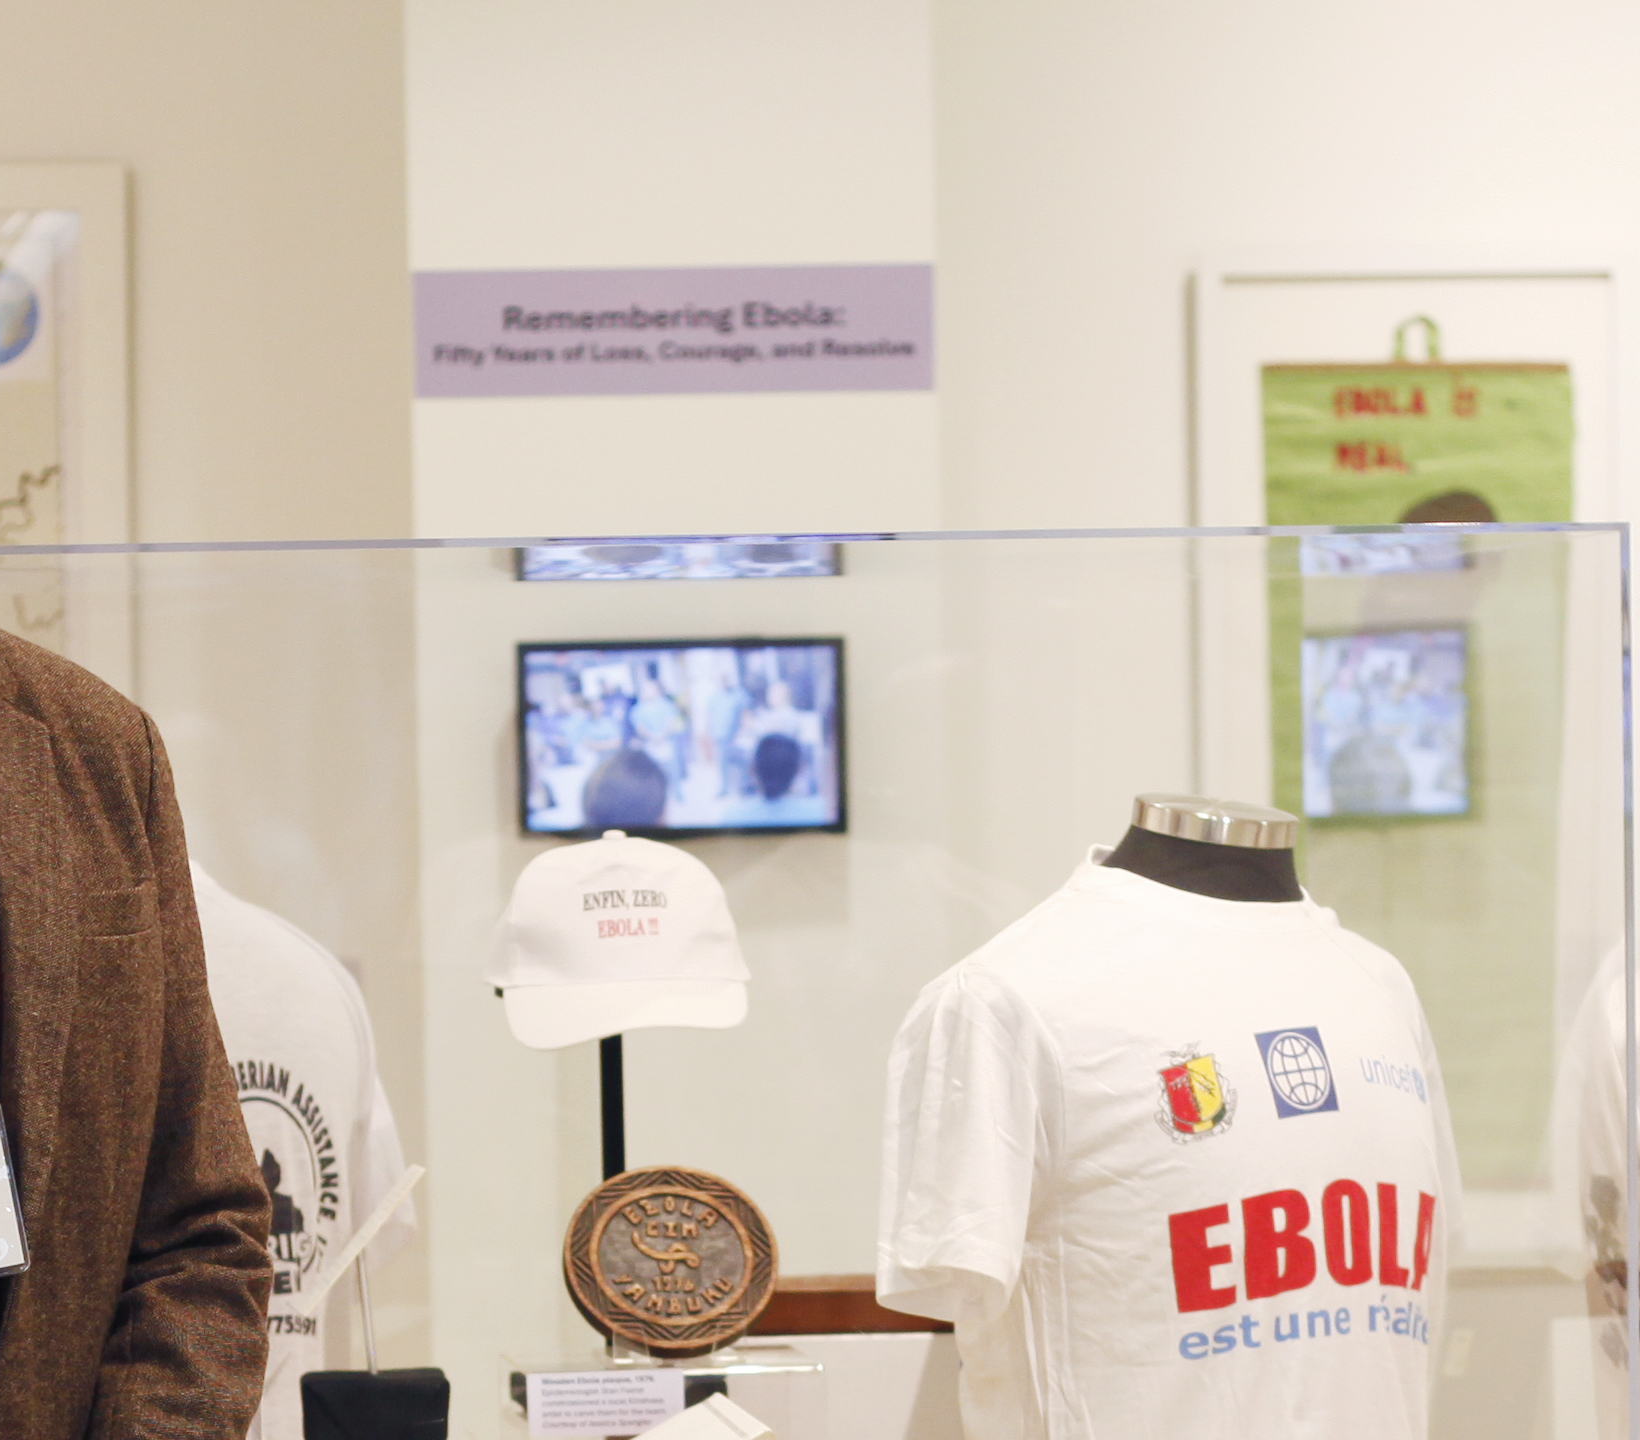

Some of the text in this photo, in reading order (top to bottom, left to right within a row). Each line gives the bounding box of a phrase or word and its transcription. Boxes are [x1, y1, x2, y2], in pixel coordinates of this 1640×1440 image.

[503, 301, 845, 333] Remembering Ebola:
[433, 344, 484, 365] Fifty
[493, 343, 555, 362] Years
[562, 342, 586, 361] of
[772, 340, 814, 359] and
[1333, 386, 1428, 418] EBOLA
[1336, 442, 1413, 473] REAL
[582, 890, 668, 911] ENFIN, ZERO
[598, 918, 645, 938] EBOLA
[291, 1083, 339, 1221] ASSISTANCE
[622, 1196, 718, 1228] EBOLA
[267, 1233, 312, 1260] RUG
[1168, 1178, 1435, 1314] EBOLA
[611, 1274, 735, 1315] YAMBUKU
[1179, 1315, 1260, 1360] est
[1274, 1307, 1351, 1342] une
